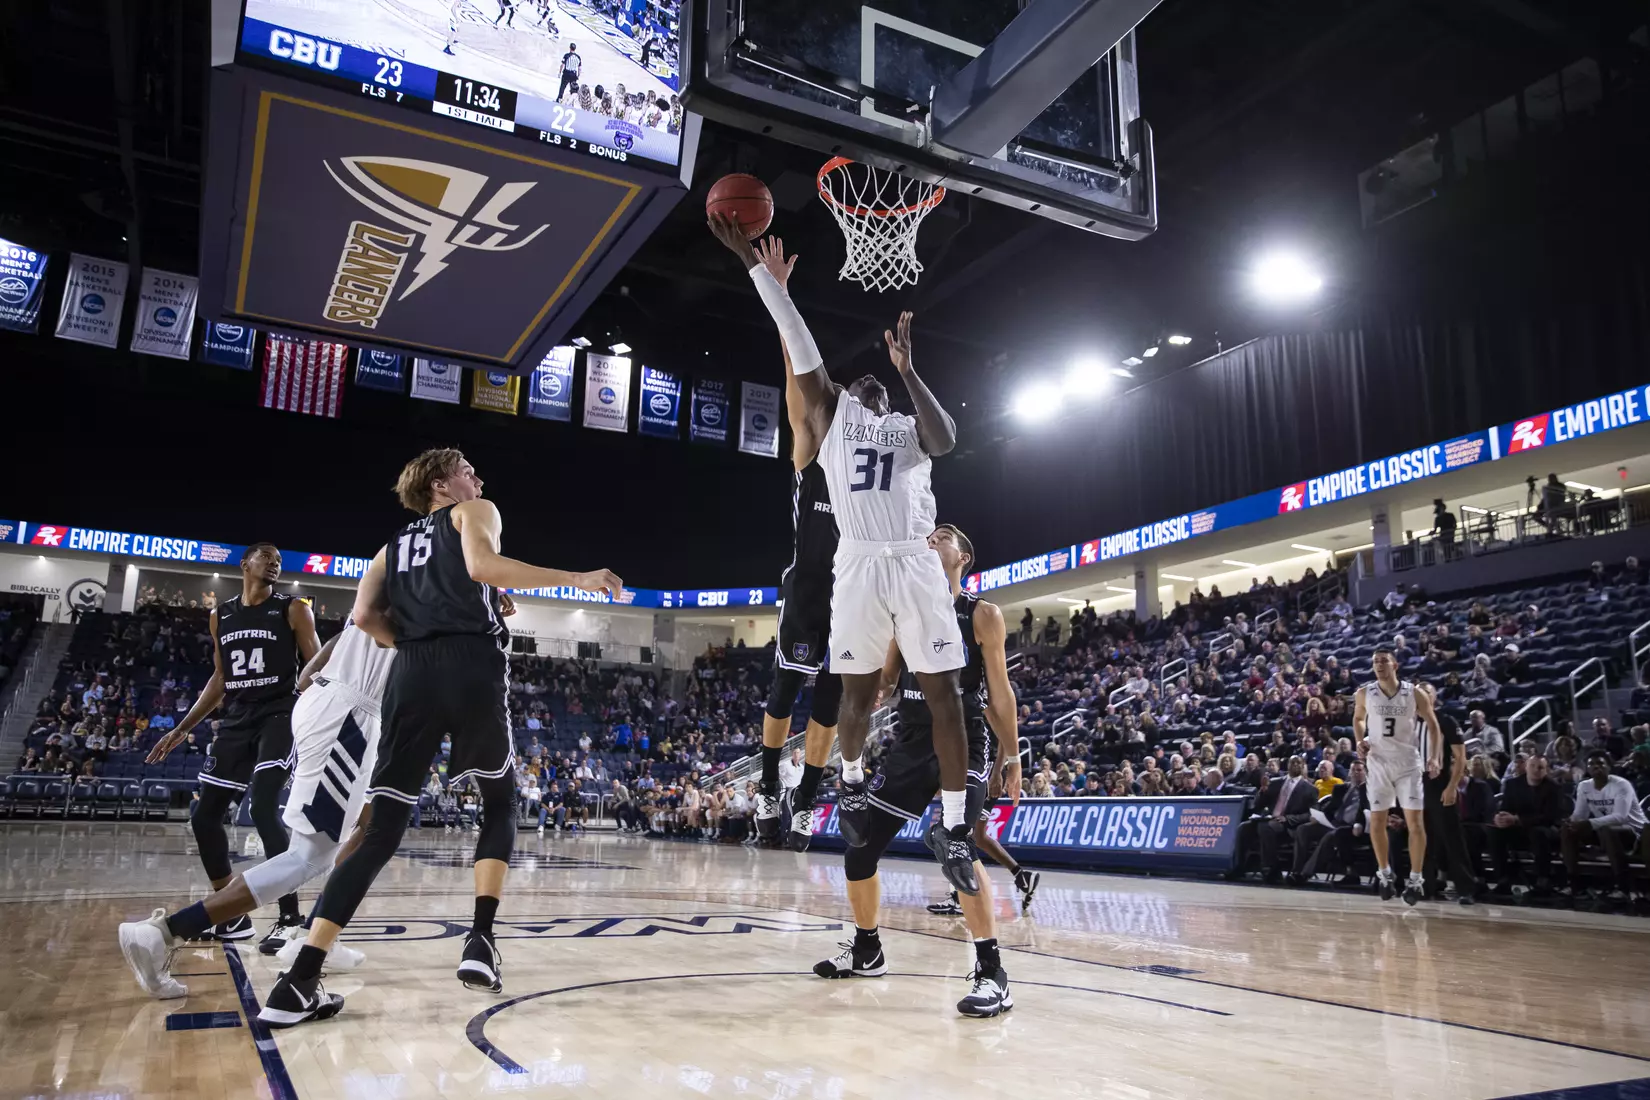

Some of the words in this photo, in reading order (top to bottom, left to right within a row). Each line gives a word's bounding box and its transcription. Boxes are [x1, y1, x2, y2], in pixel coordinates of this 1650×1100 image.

[269, 29, 342, 71] CBU
[374, 57, 403, 87] 23
[361, 83, 386, 99] FLS
[396, 92, 404, 102] 7
[455, 79, 500, 111] 11:34
[448, 106, 467, 118] 1ST
[475, 113, 503, 128] HALF
[551, 106, 577, 134] 22
[539, 130, 562, 146] FLS
[570, 138, 577, 149] 2
[589, 143, 628, 162] BONUS
[0, 247, 37, 262] 2016
[1, 258, 31, 270] MEN'S
[0, 266, 42, 280] SKETBALL
[82, 263, 116, 278] 2015
[323, 220, 417, 329] LANCERS
[69, 280, 122, 296] BASKETBALL
[153, 276, 185, 291] 2014
[67, 322, 98, 334] SWEET
[646, 378, 676, 389] WOMEN'S
[650, 369, 674, 381] 2017
[528, 396, 569, 408] CHAMPIONS
[1512, 421, 1544, 449] 2K
[1553, 389, 1641, 442] EMPIRE
[850, 448, 895, 492] 31
[1281, 487, 1303, 511] 2K
[1308, 465, 1367, 506] EMPIRE
[1368, 445, 1443, 490] CLASSIC
[37, 526, 62, 546] 2K
[69, 528, 130, 554] EMPIRE
[132, 534, 198, 560] CLASSIC
[1081, 543, 1097, 563] 2K
[1101, 529, 1141, 560] EMPIRE
[1141, 515, 1190, 549] CLASSIC
[397, 525, 434, 573] 15
[307, 555, 329, 573] 2K
[333, 556, 373, 578] EMPI
[981, 565, 1012, 591] EMPIRE
[1012, 554, 1049, 583] CLASSIC
[10, 583, 61, 594] BIBLICALLY
[749, 589, 763, 605] 23
[698, 591, 729, 606] CBU
[220, 629, 277, 645] CENTRAL
[510, 628, 536, 636] OBALLY
[230, 647, 266, 676] 24
[225, 675, 279, 690] ARKANSAS
[1383, 717, 1397, 737] 3
[1008, 805, 1082, 845] EMPIRE
[1079, 805, 1175, 849] CLASSIC
[1180, 815, 1230, 825] WOUNDED
[1177, 826, 1223, 837] WARRIOR
[1174, 836, 1218, 848] PROJECT
